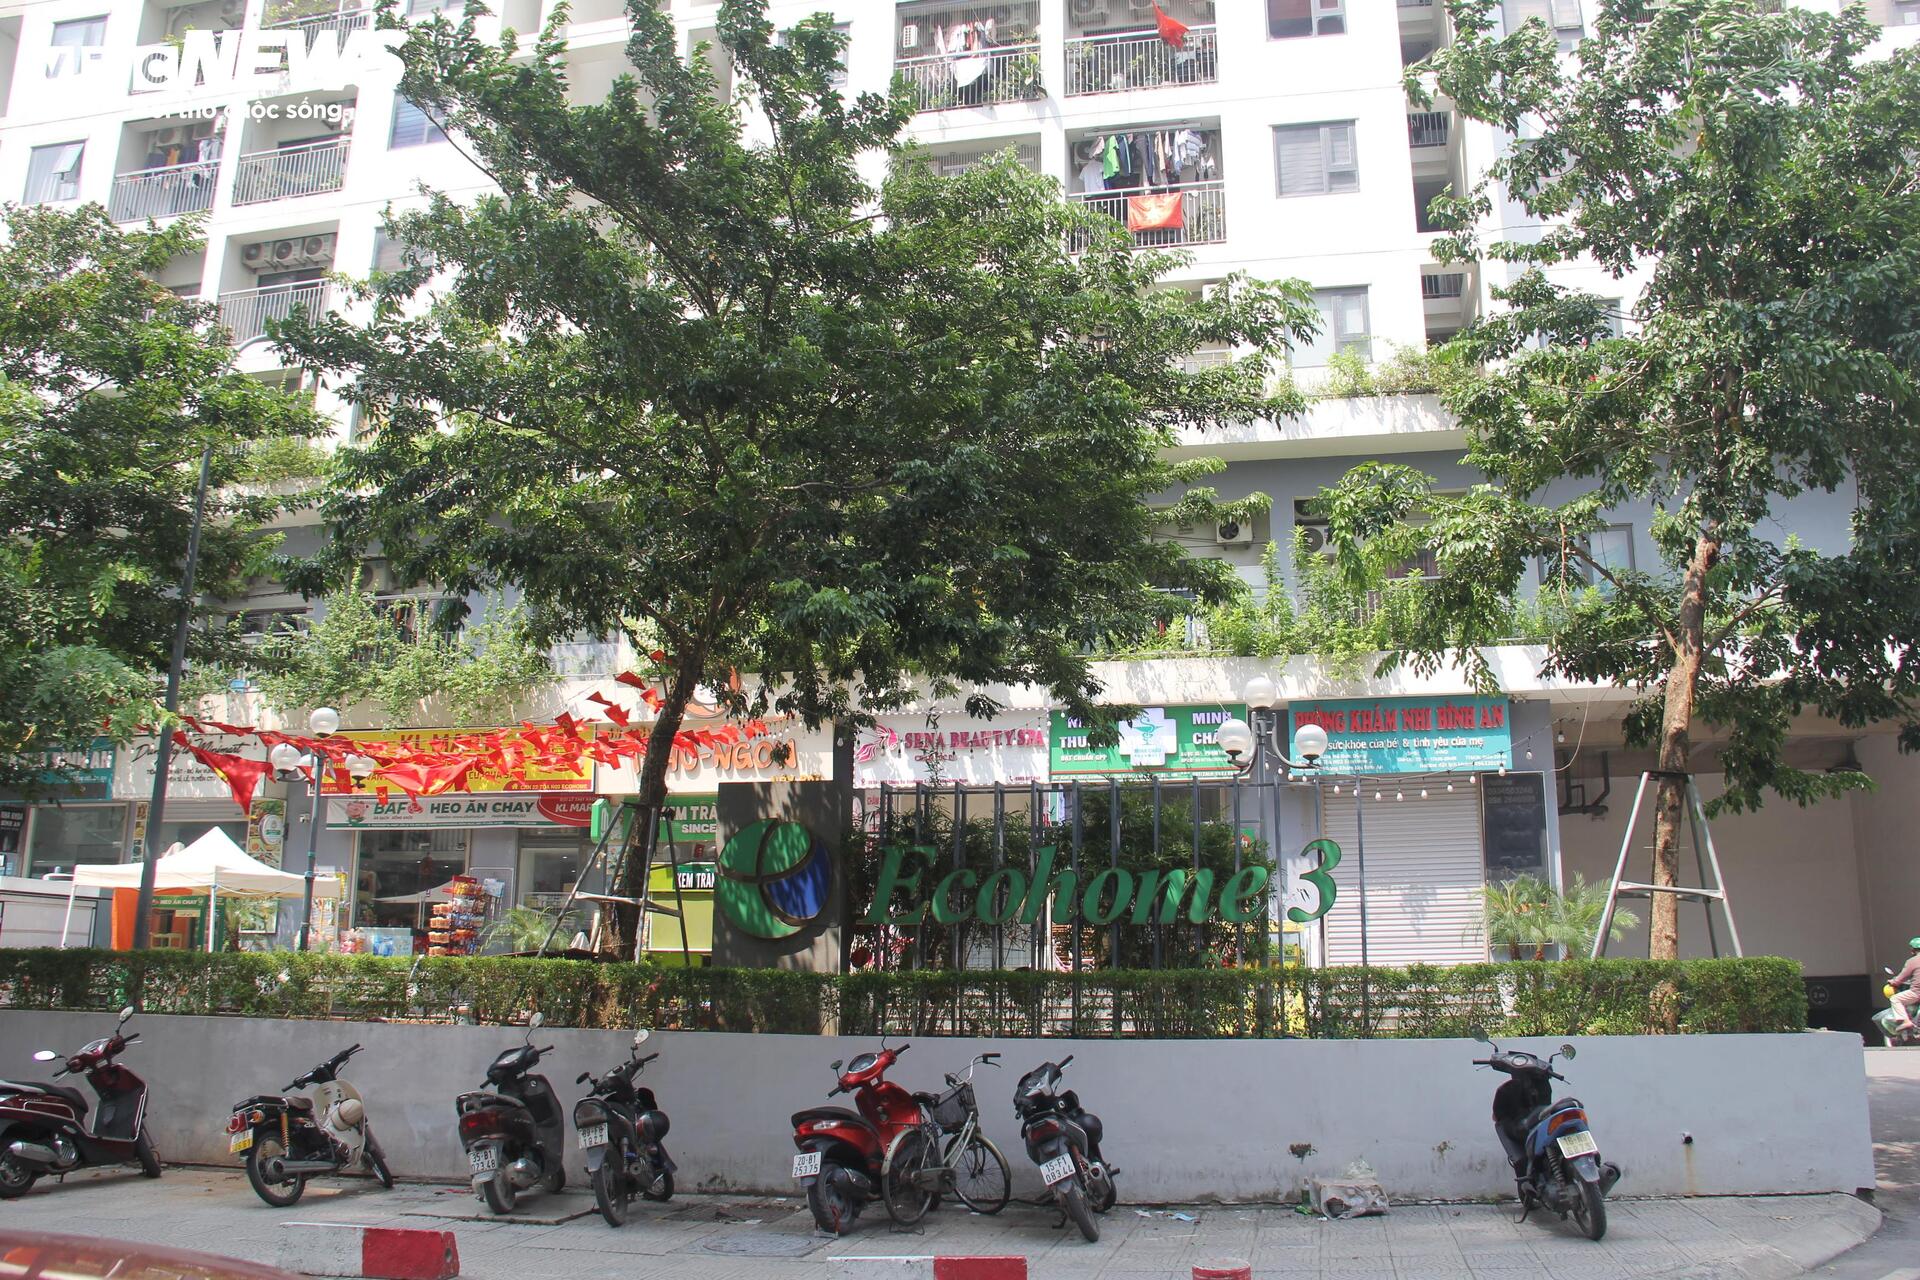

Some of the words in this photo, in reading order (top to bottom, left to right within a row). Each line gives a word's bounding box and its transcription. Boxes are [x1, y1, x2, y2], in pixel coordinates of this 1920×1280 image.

[1192, 711, 1232, 725] MINH
[1350, 703, 1398, 732] KHÁM
[1402, 707, 1432, 731] NHI
[1436, 700, 1475, 729] BÌNH
[1480, 705, 1504, 728] AN
[904, 732, 946, 749] SENA
[950, 730, 1014, 748] BEAUTY
[1016, 729, 1046, 747] SPA
[1192, 729, 1219, 745] CHÂ
[1327, 739, 1344, 750] sức
[1368, 740, 1385, 749] của
[1386, 737, 1399, 749] bé
[1402, 738, 1410, 747] &
[1413, 737, 1430, 748] tình
[1433, 736, 1449, 750] yêu
[1450, 736, 1467, 747] của
[1469, 737, 1484, 749] mẹ
[430, 802, 462, 814] HEO
[465, 799, 487, 813] ĂN
[491, 801, 535, 813] CHAY
[555, 803, 568, 812] KL
[569, 803, 593, 812] MAR
[681, 823, 717, 834] SINCE
[856, 845, 1269, 926] Ecohome
[1287, 839, 1342, 922] 3
[471, 1149, 493, 1163] 35-B1
[797, 1154, 817, 1166] 20-B1
[1045, 1157, 1068, 1172] 15-F1
